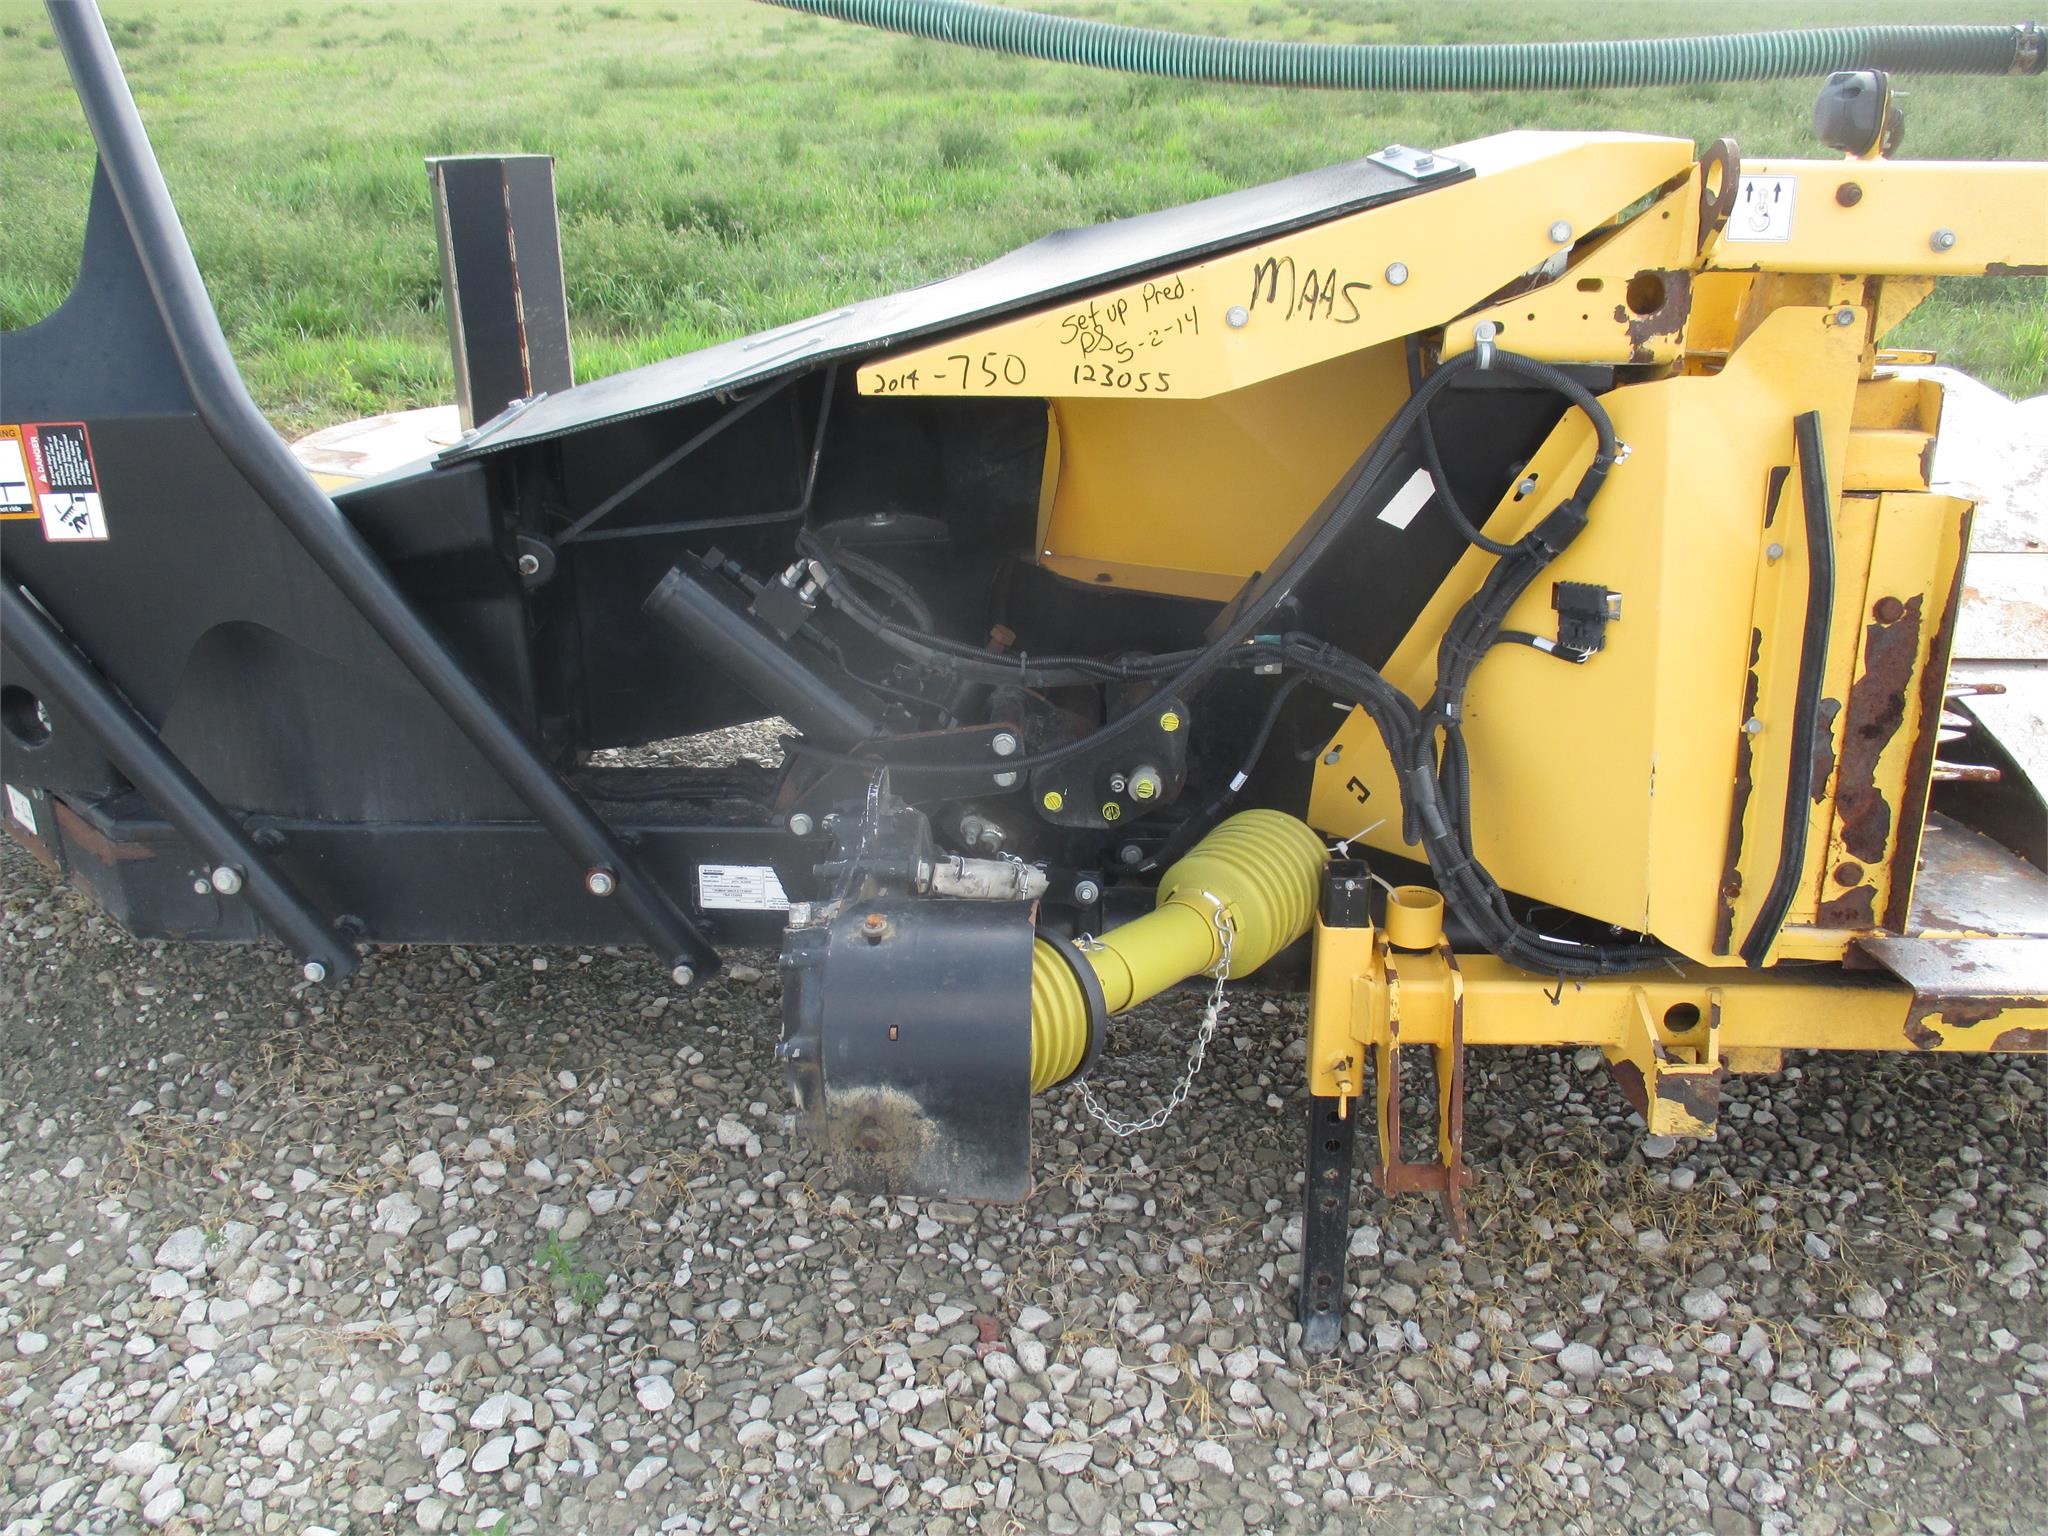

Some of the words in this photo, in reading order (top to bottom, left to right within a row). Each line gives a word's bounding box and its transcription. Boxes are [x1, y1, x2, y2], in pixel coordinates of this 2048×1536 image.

[1249, 255, 1373, 324] MAAS
[1073, 363, 1171, 393] 123055
[30, 435, 45, 473] DANGER
